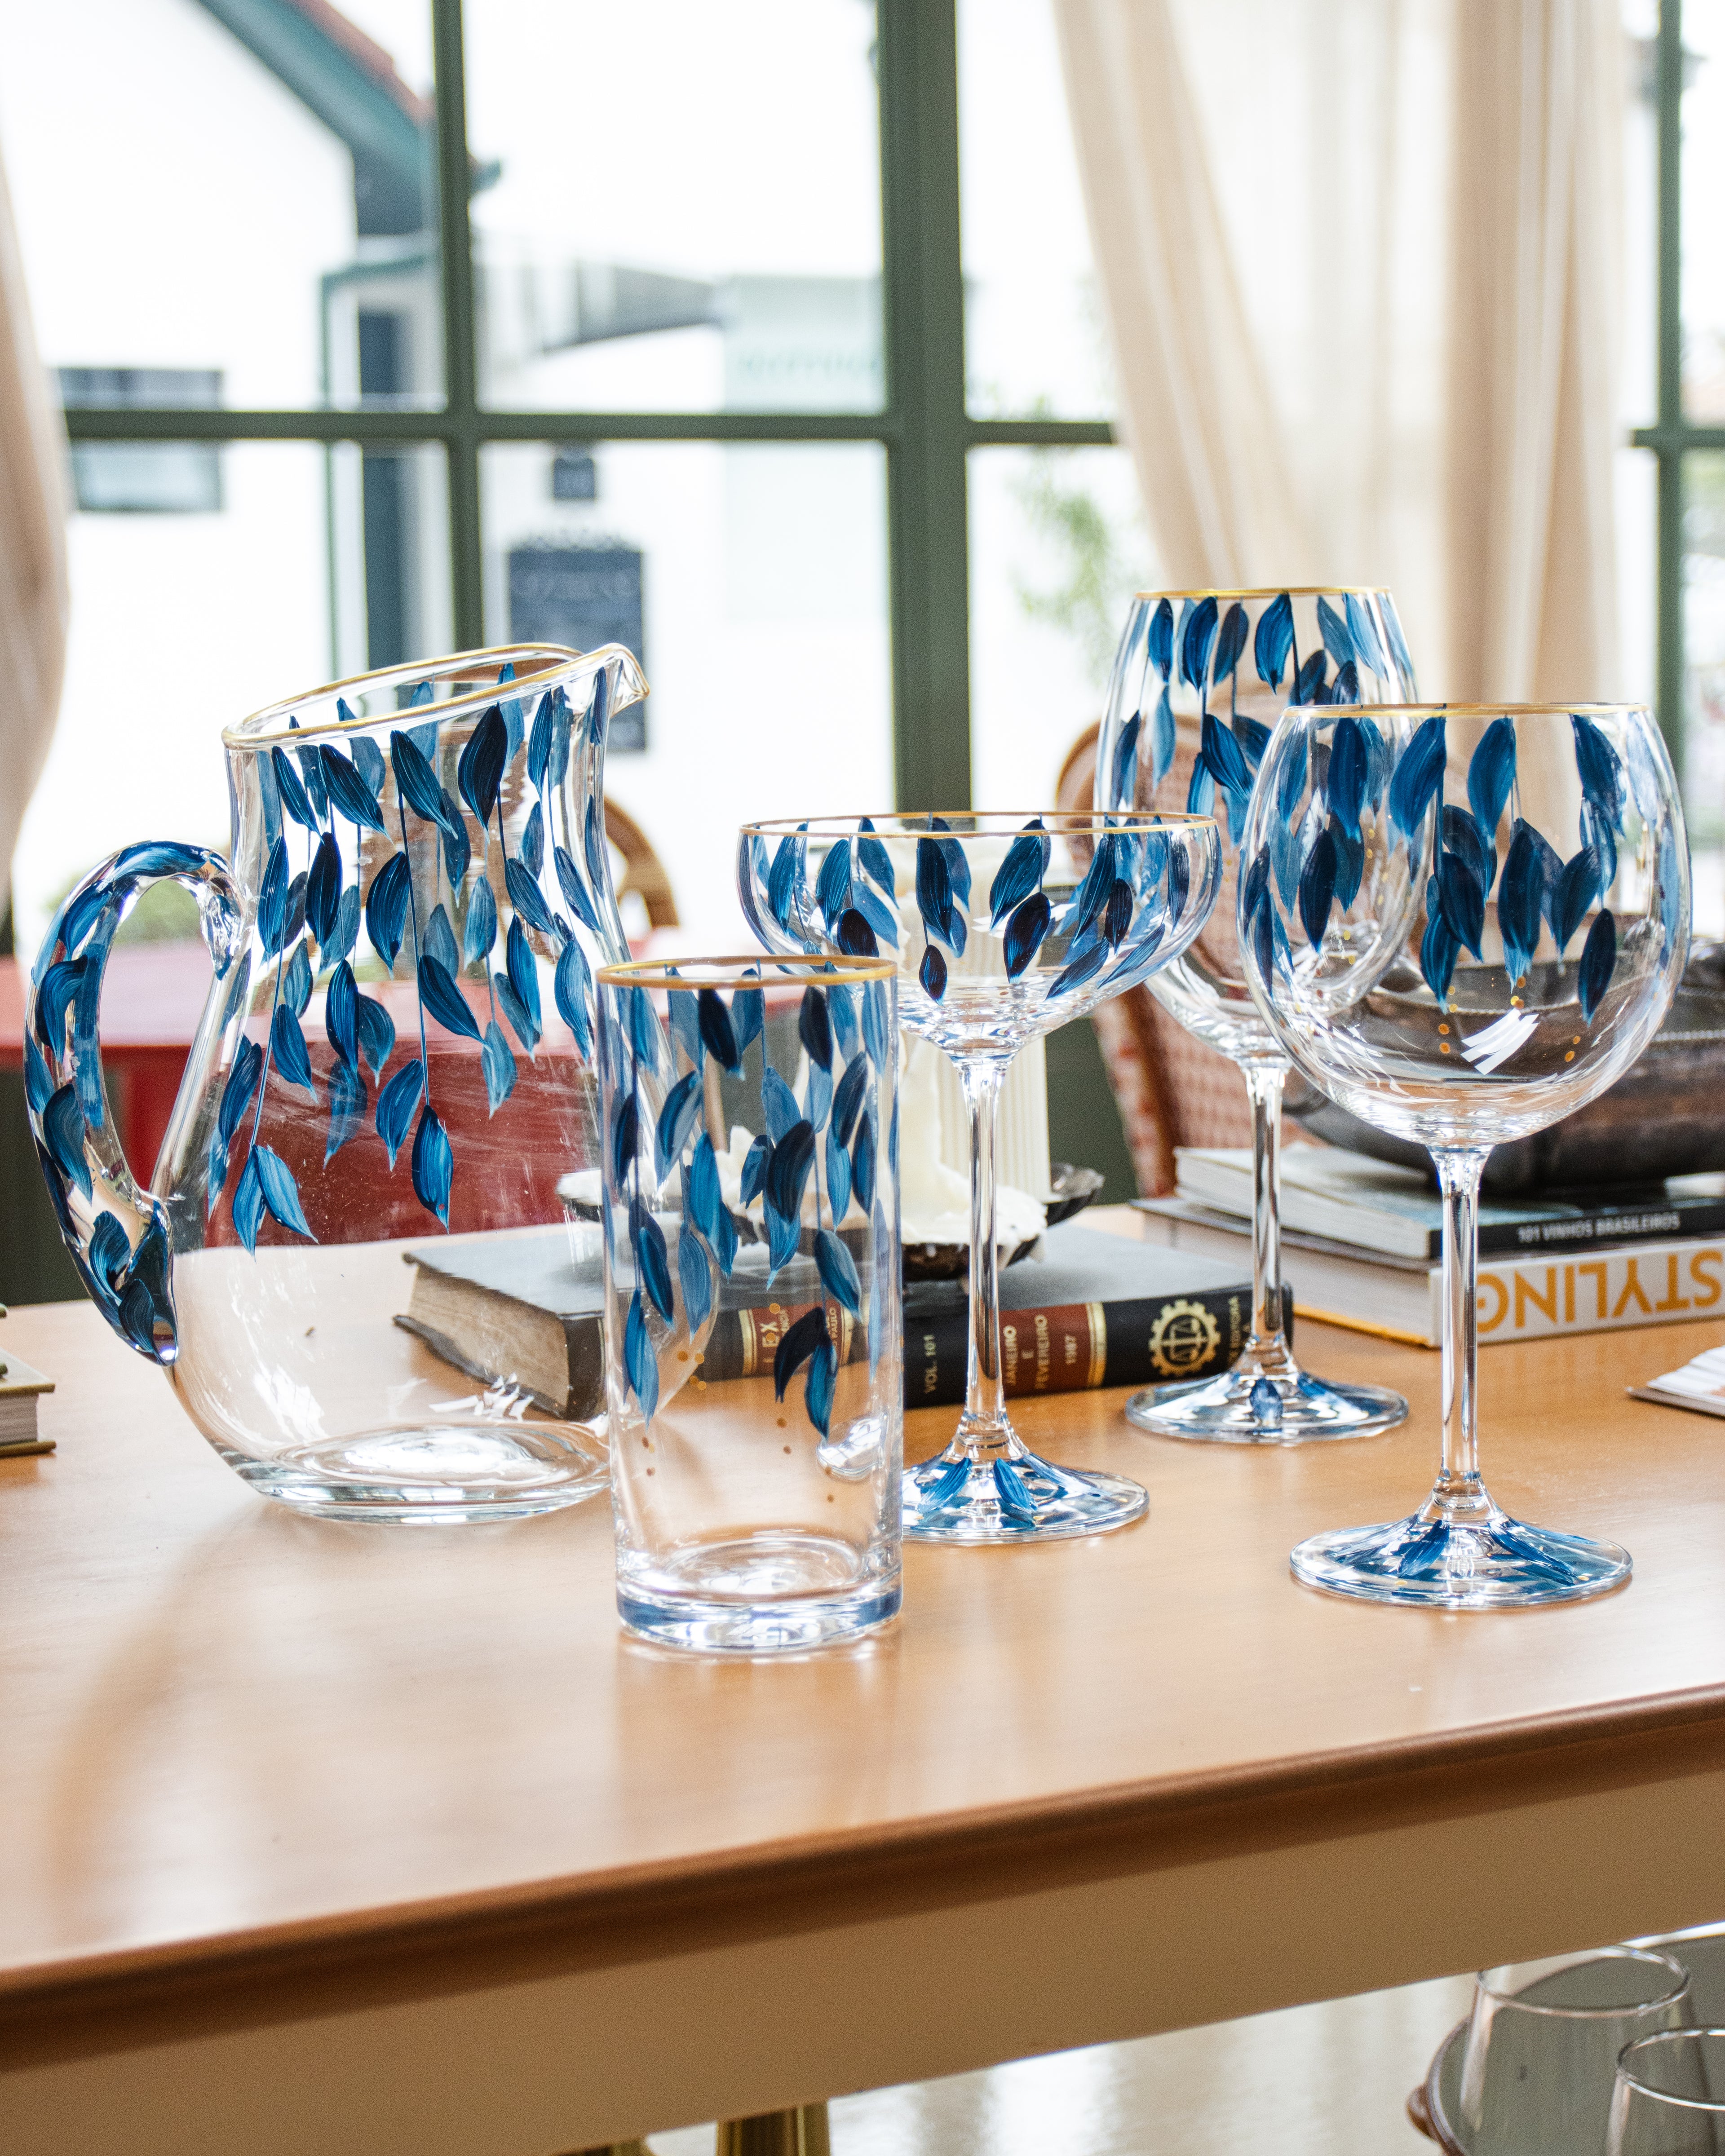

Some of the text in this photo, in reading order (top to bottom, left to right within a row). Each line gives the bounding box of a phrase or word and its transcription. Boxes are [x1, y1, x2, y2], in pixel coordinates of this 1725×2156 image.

[1542, 1219, 1593, 1241] VINHOS
[1596, 1212, 1681, 1236] BRASILEIROS
[1477, 1250, 1724, 1334] STYLING
[830, 1307, 838, 1338] PAULO
[923, 1334, 937, 1357] 101
[1003, 1325, 1018, 1386] JANEIRO
[1022, 1350, 1034, 1360] E
[1035, 1314, 1050, 1389] FEVEREIRO
